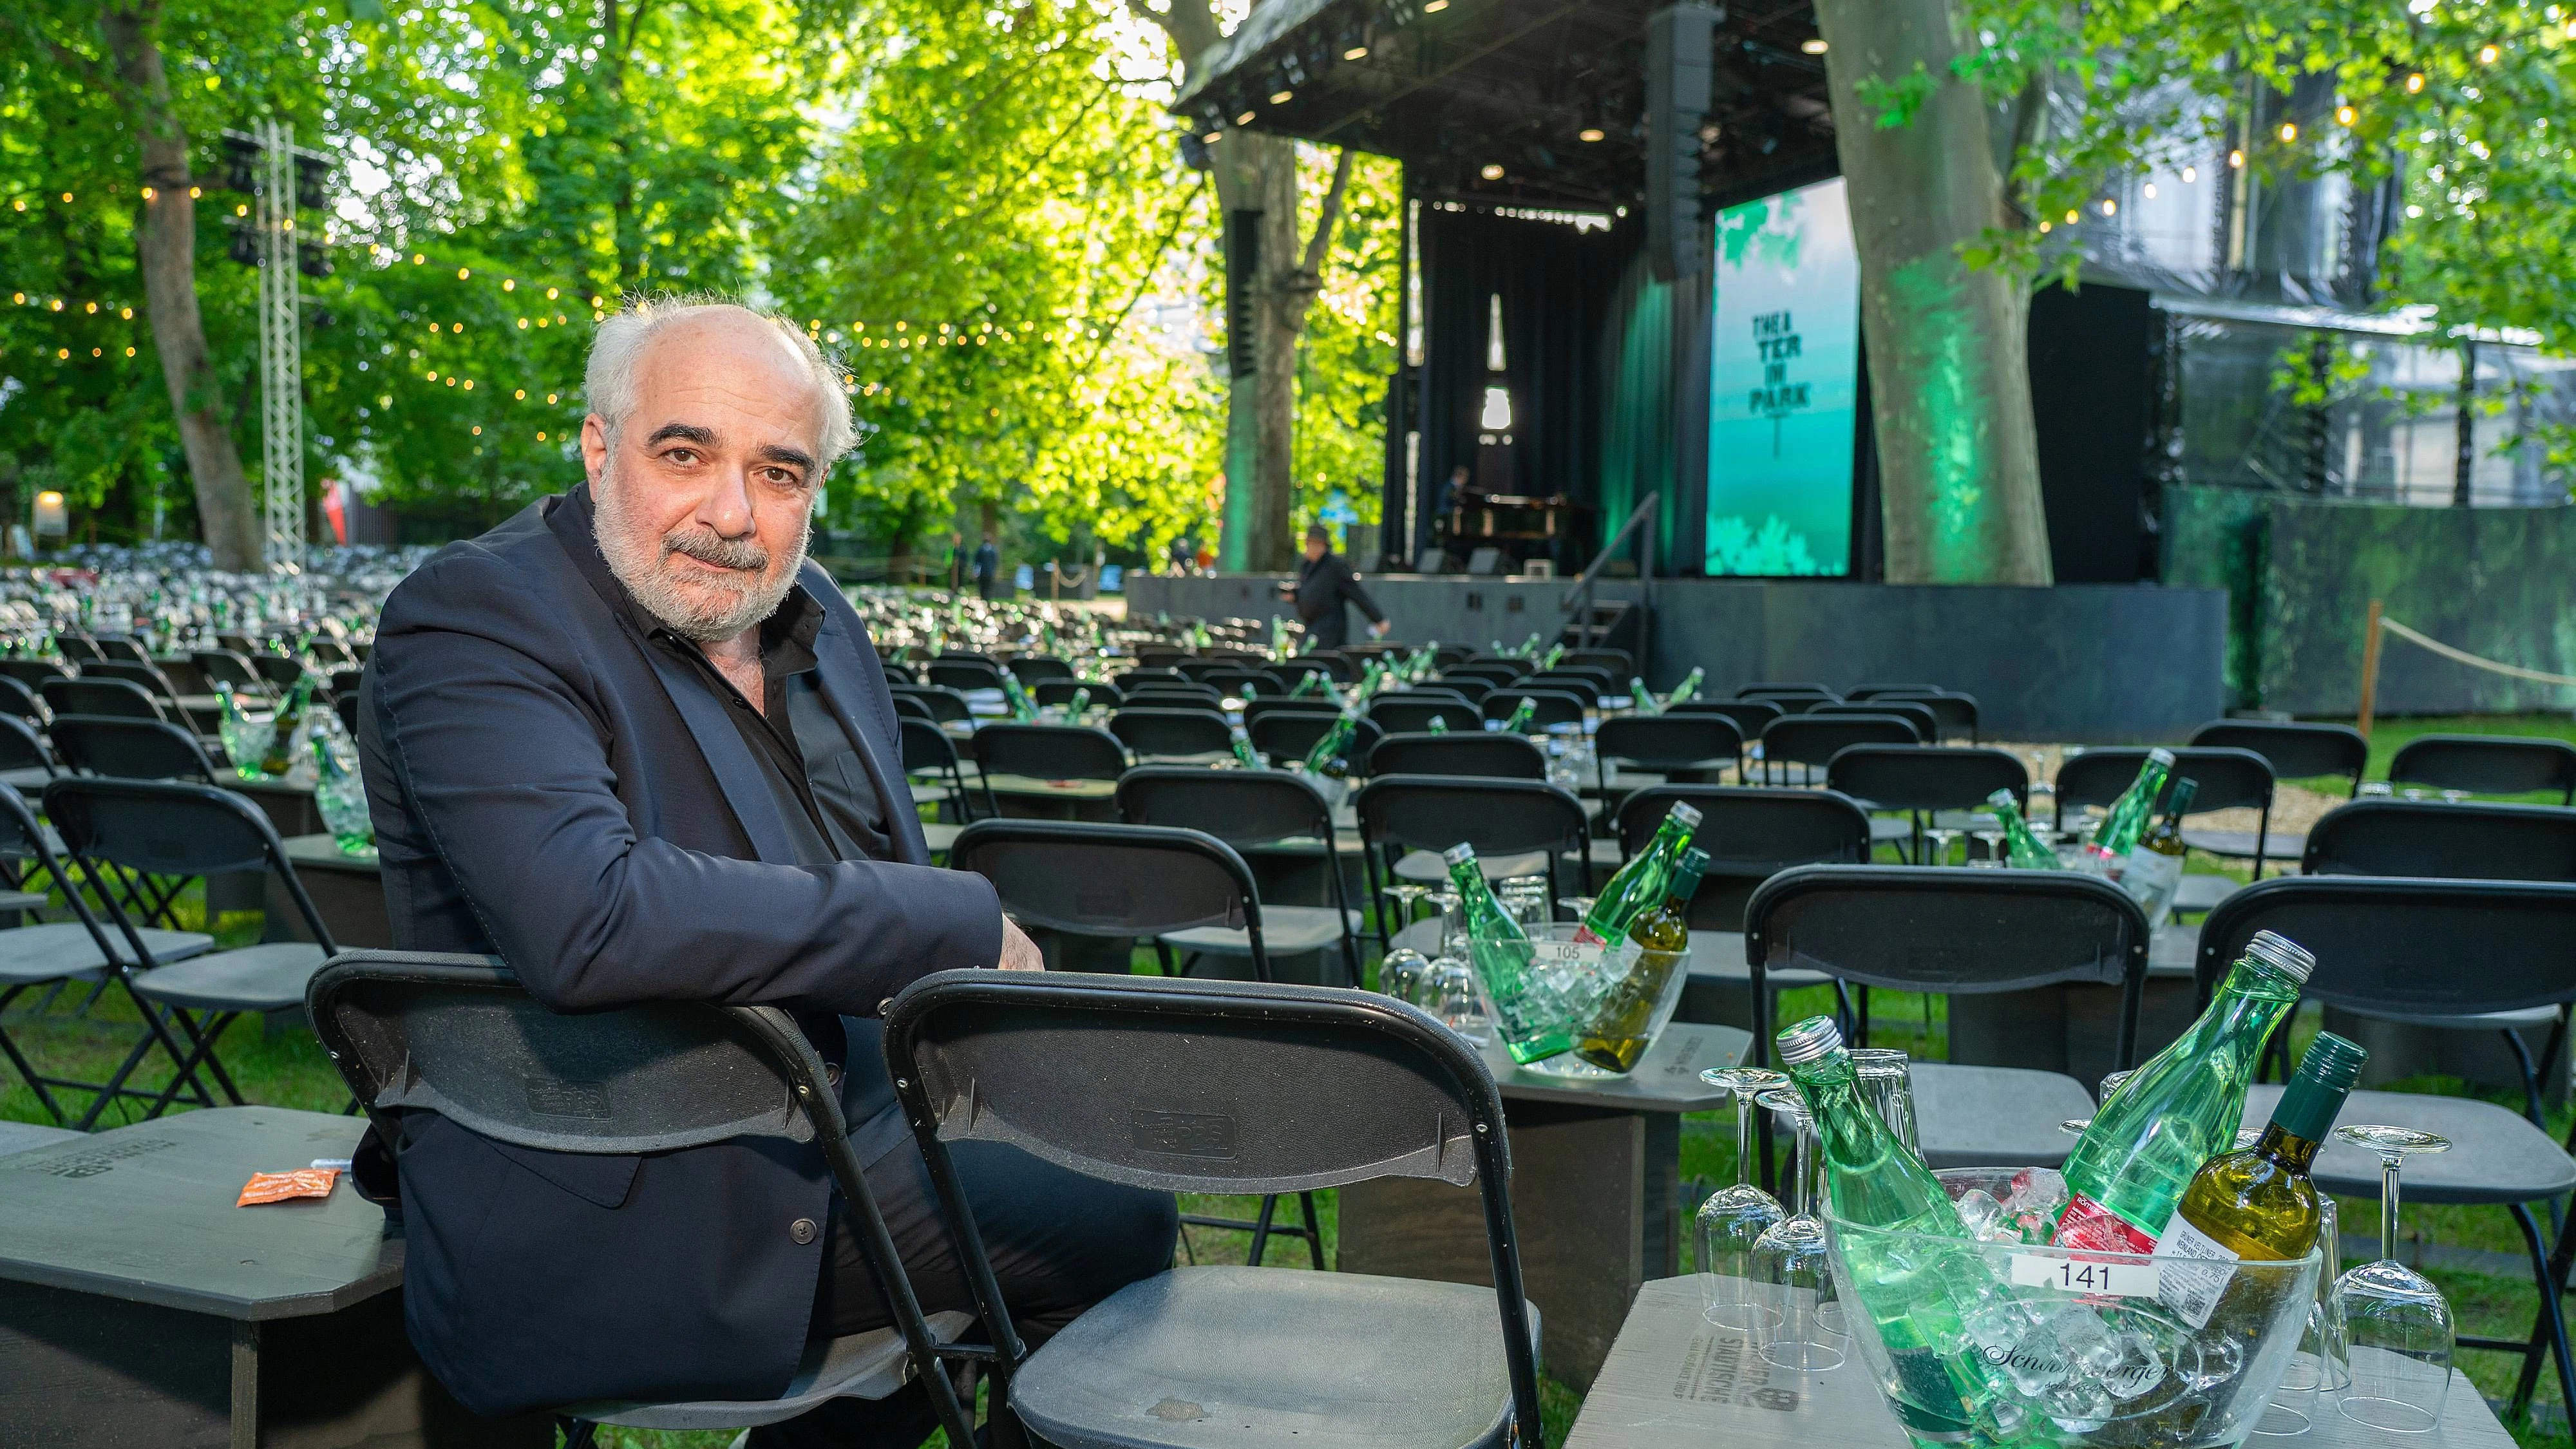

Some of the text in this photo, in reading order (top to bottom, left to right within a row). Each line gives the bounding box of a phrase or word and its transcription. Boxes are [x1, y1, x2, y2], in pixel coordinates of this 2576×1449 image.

[1759, 334, 1801, 362] TER
[1749, 382, 1812, 415] PARK
[1557, 945, 1580, 959] 105
[2175, 1238, 2198, 1258] WEINLAND
[2179, 1229, 2195, 1244] GRÜNER
[2193, 1240, 2216, 1258] VELTLINER
[2060, 1263, 2109, 1290] 141
